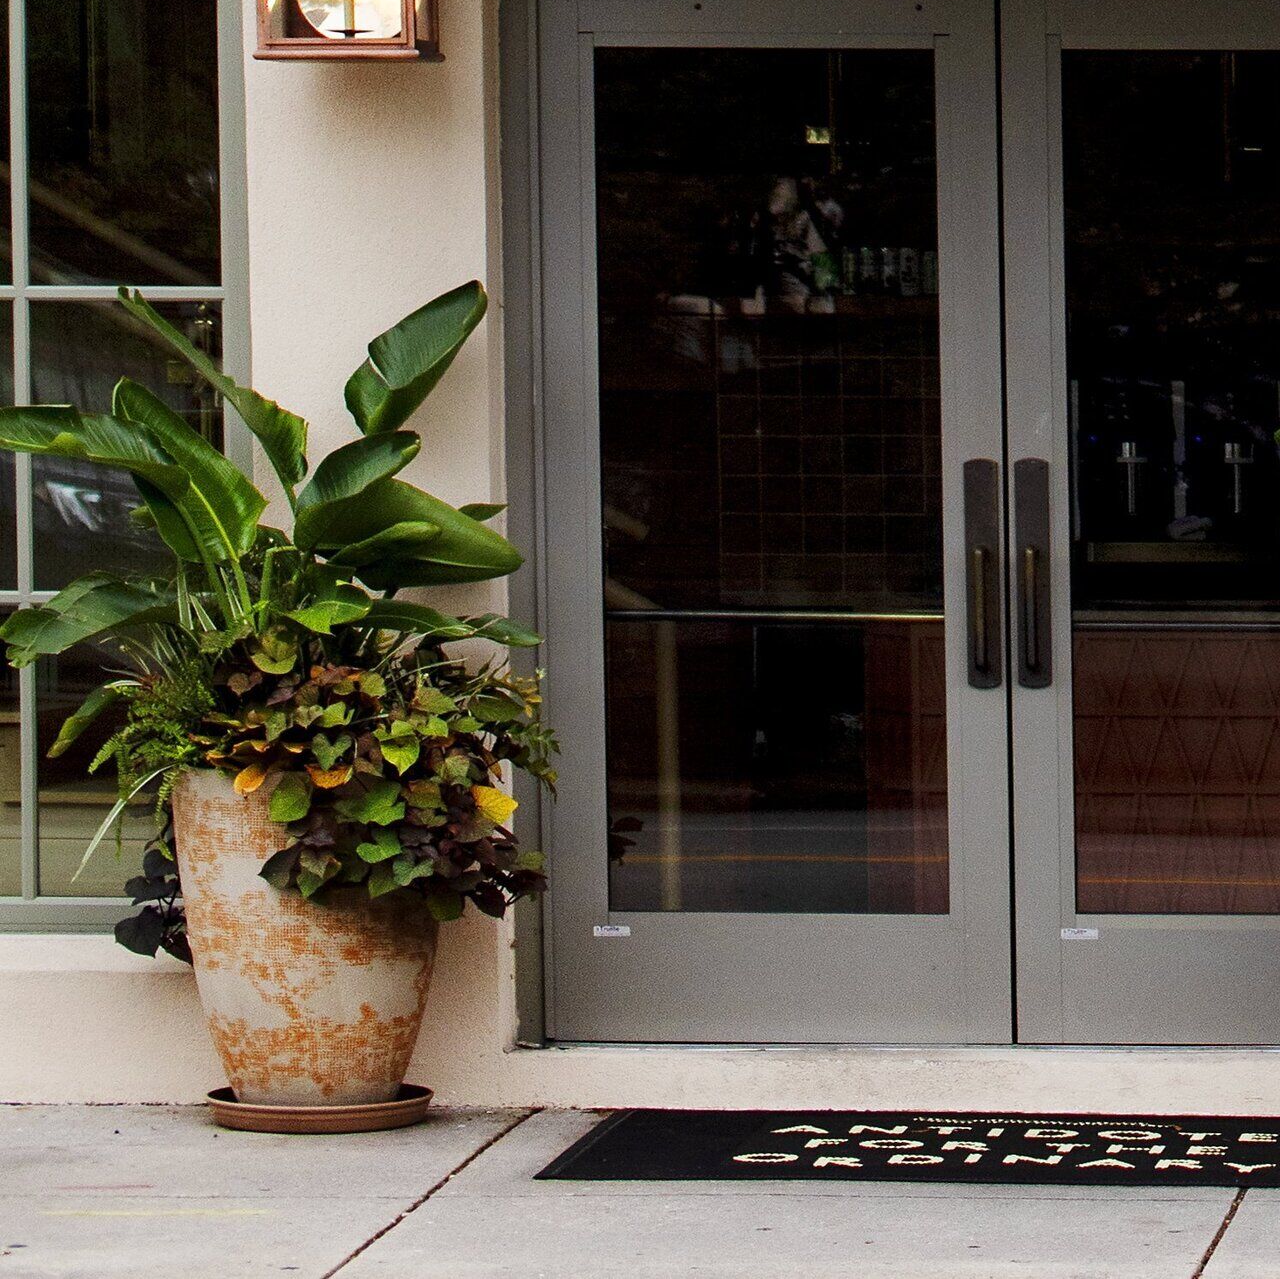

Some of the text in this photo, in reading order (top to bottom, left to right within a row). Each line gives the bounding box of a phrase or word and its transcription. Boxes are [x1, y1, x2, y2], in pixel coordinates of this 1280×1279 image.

[770, 1124, 1279, 1142] ANTIDOTE
[804, 1138, 1229, 1156] FOR THE
[732, 1152, 1277, 1173] ORDINARY
